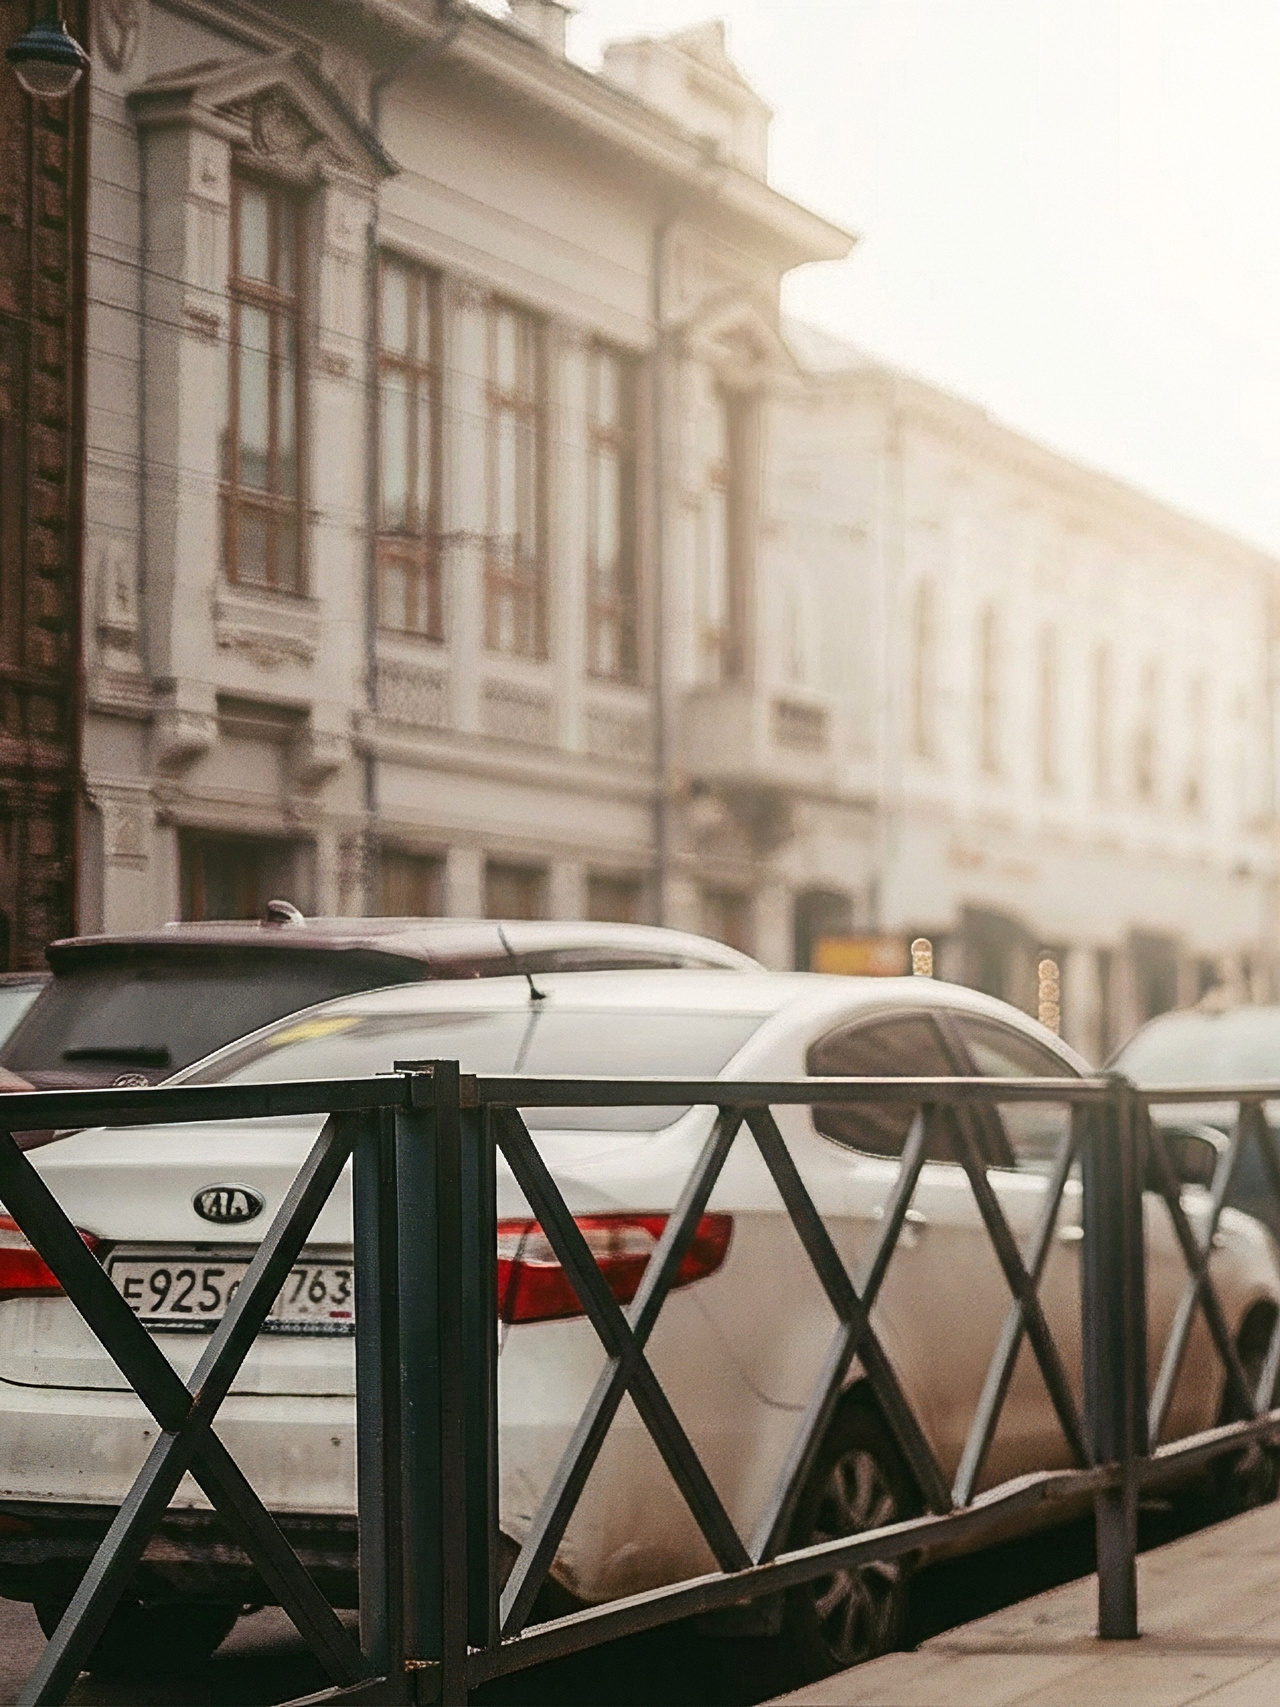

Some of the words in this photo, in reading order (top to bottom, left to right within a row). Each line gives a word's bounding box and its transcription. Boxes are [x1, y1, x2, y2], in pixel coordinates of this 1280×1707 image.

[200, 1191, 251, 1216] KIA
[123, 1269, 272, 1314] E925
[290, 1270, 351, 1305] 763
